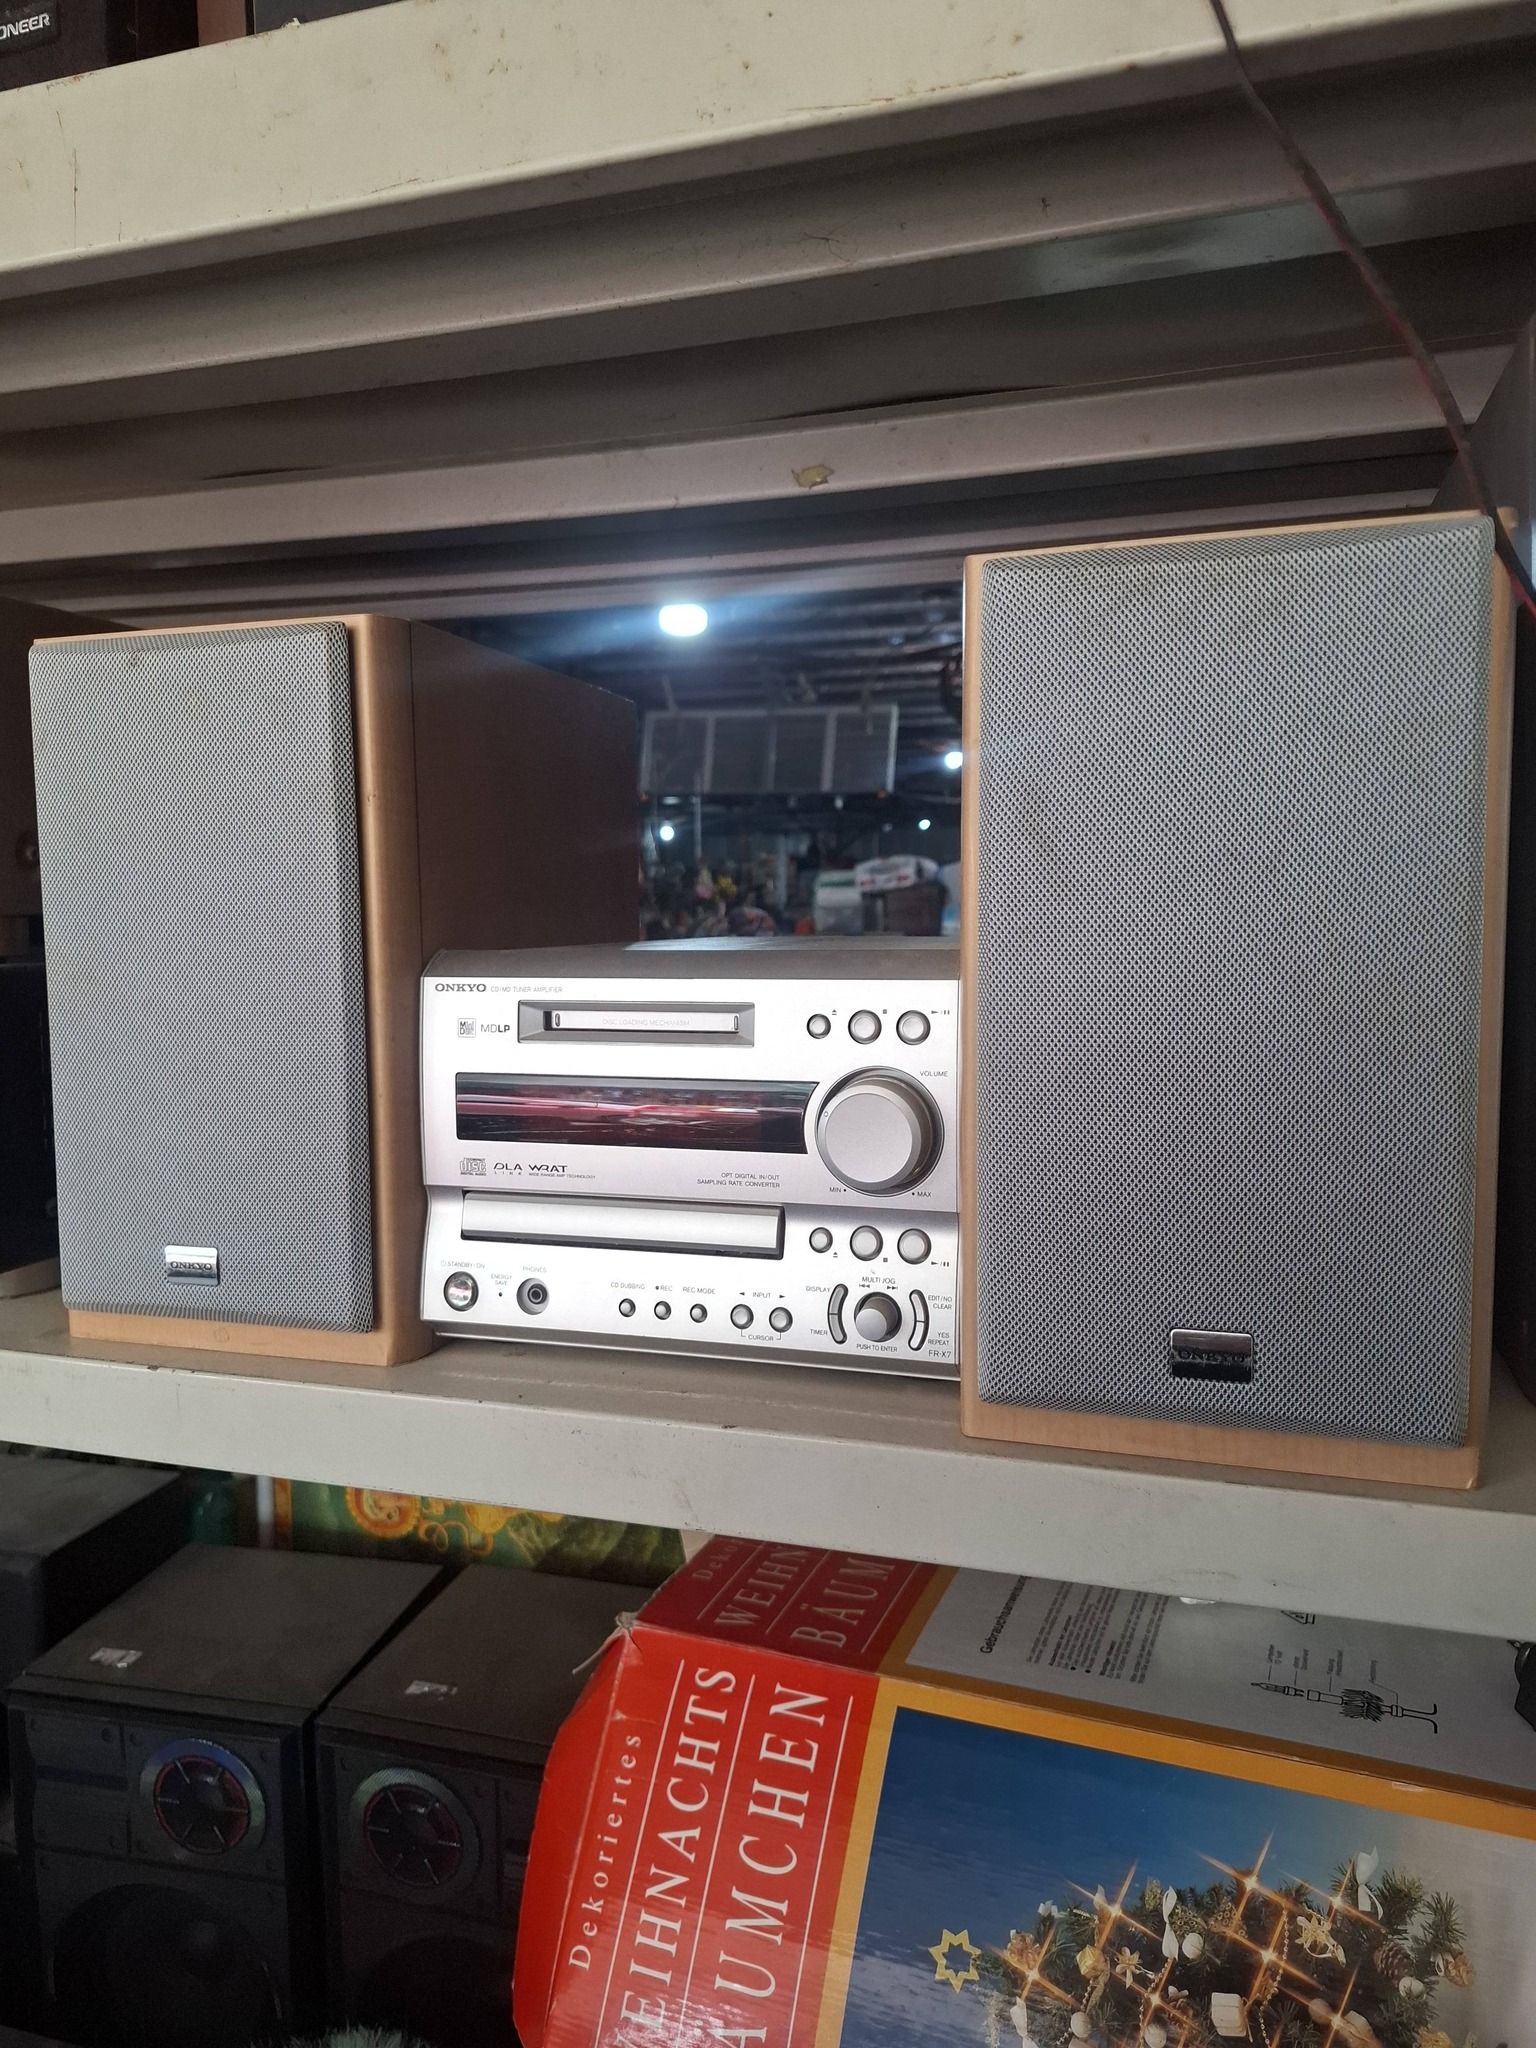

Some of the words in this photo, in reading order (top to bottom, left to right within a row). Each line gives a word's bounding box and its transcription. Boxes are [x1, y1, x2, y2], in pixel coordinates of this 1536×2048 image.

[434, 983, 487, 993] ONKYO
[602, 1018, 618, 1026] DISC
[649, 1019, 690, 1027] MECHANISM
[480, 1024, 511, 1033] MDLP
[919, 1070, 949, 1078] VOLUME
[522, 1266, 547, 1274] PHONES
[620, 1282, 645, 1290] DUBBING
[660, 1284, 673, 1292] REC
[805, 1285, 831, 1293] DISPLAY
[697, 1287, 716, 1295] MODE
[752, 1291, 771, 1299] INPUT
[810, 1328, 828, 1336] TIMER
[748, 1334, 774, 1342] CURSOR
[568, 1734, 642, 1970] Dekoriertes
